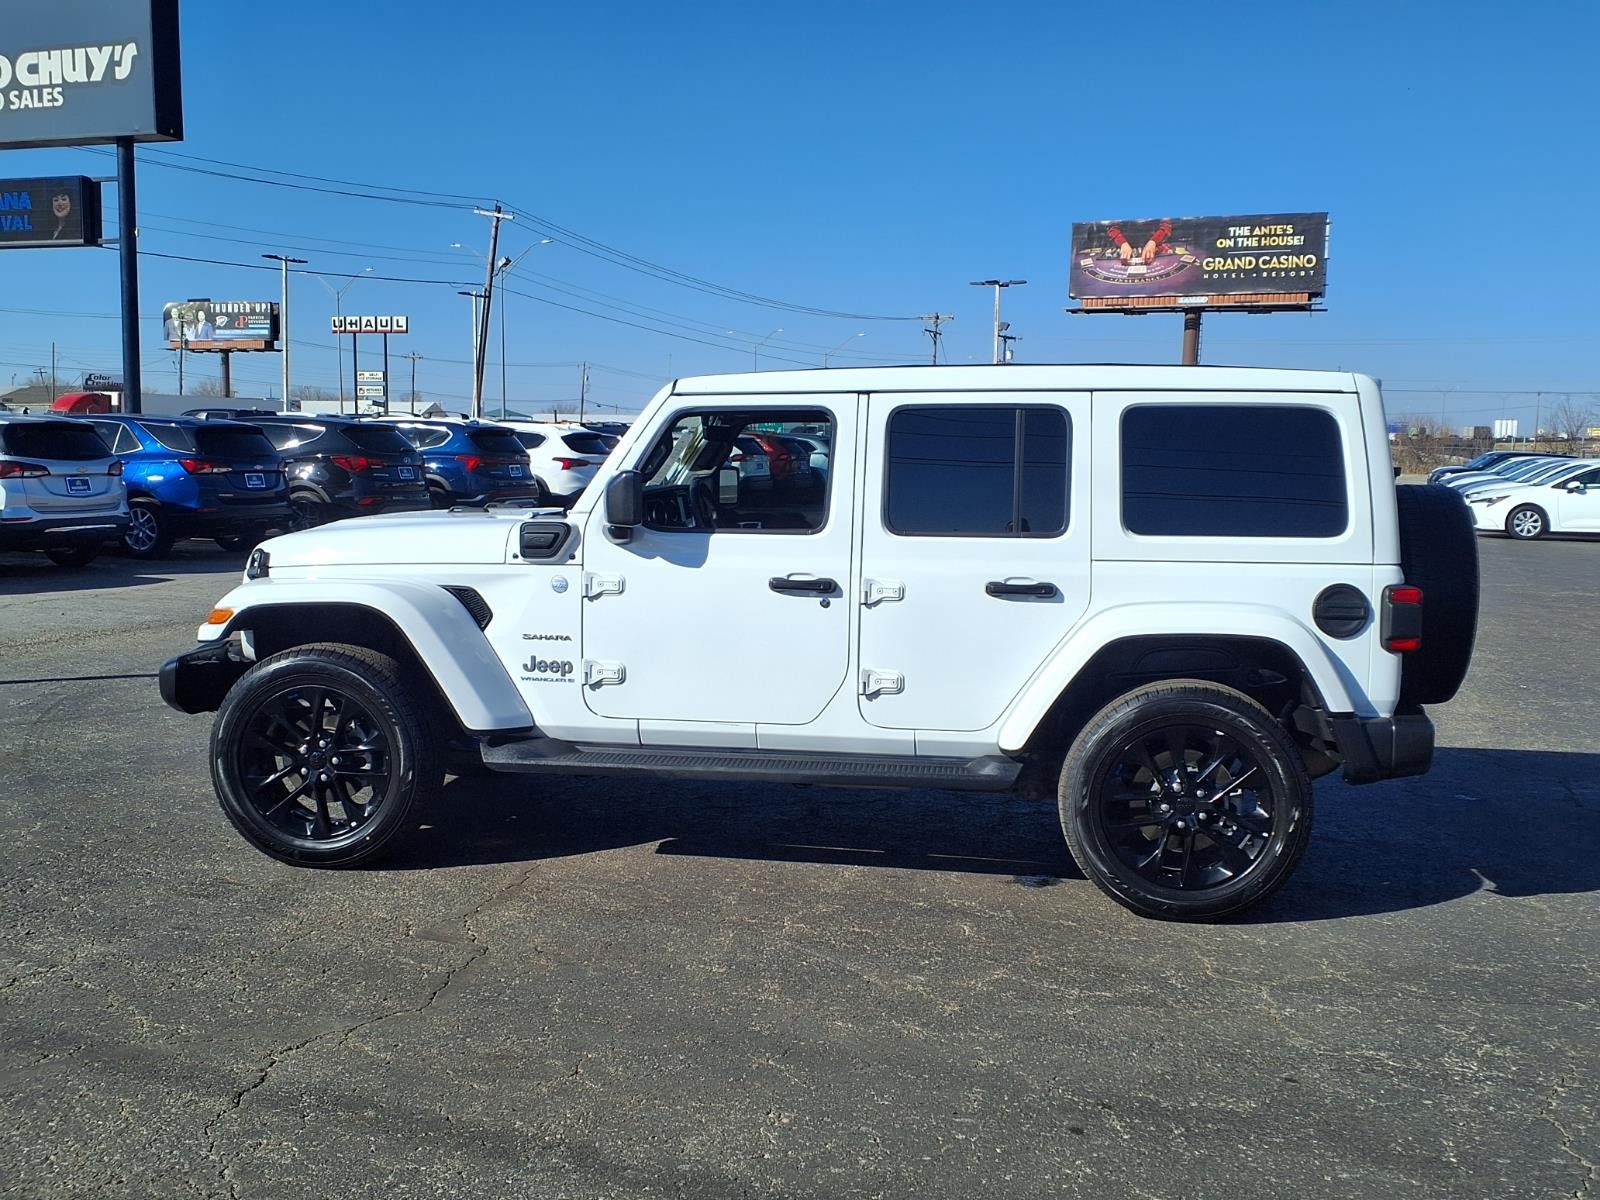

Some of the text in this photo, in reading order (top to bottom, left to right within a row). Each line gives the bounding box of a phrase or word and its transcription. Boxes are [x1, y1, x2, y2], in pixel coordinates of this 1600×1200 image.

[9, 87, 64, 110] SALES
[1228, 225, 1294, 236] THE ANTE'S
[1216, 235, 1305, 248] ON THE HOUSE!
[1202, 254, 1317, 270] GRAND CASINO
[1262, 270, 1315, 278] RESORT
[210, 303, 271, 313] THUNDER UP!
[522, 633, 573, 642] SAHARA
[522, 655, 574, 677] Jeep
